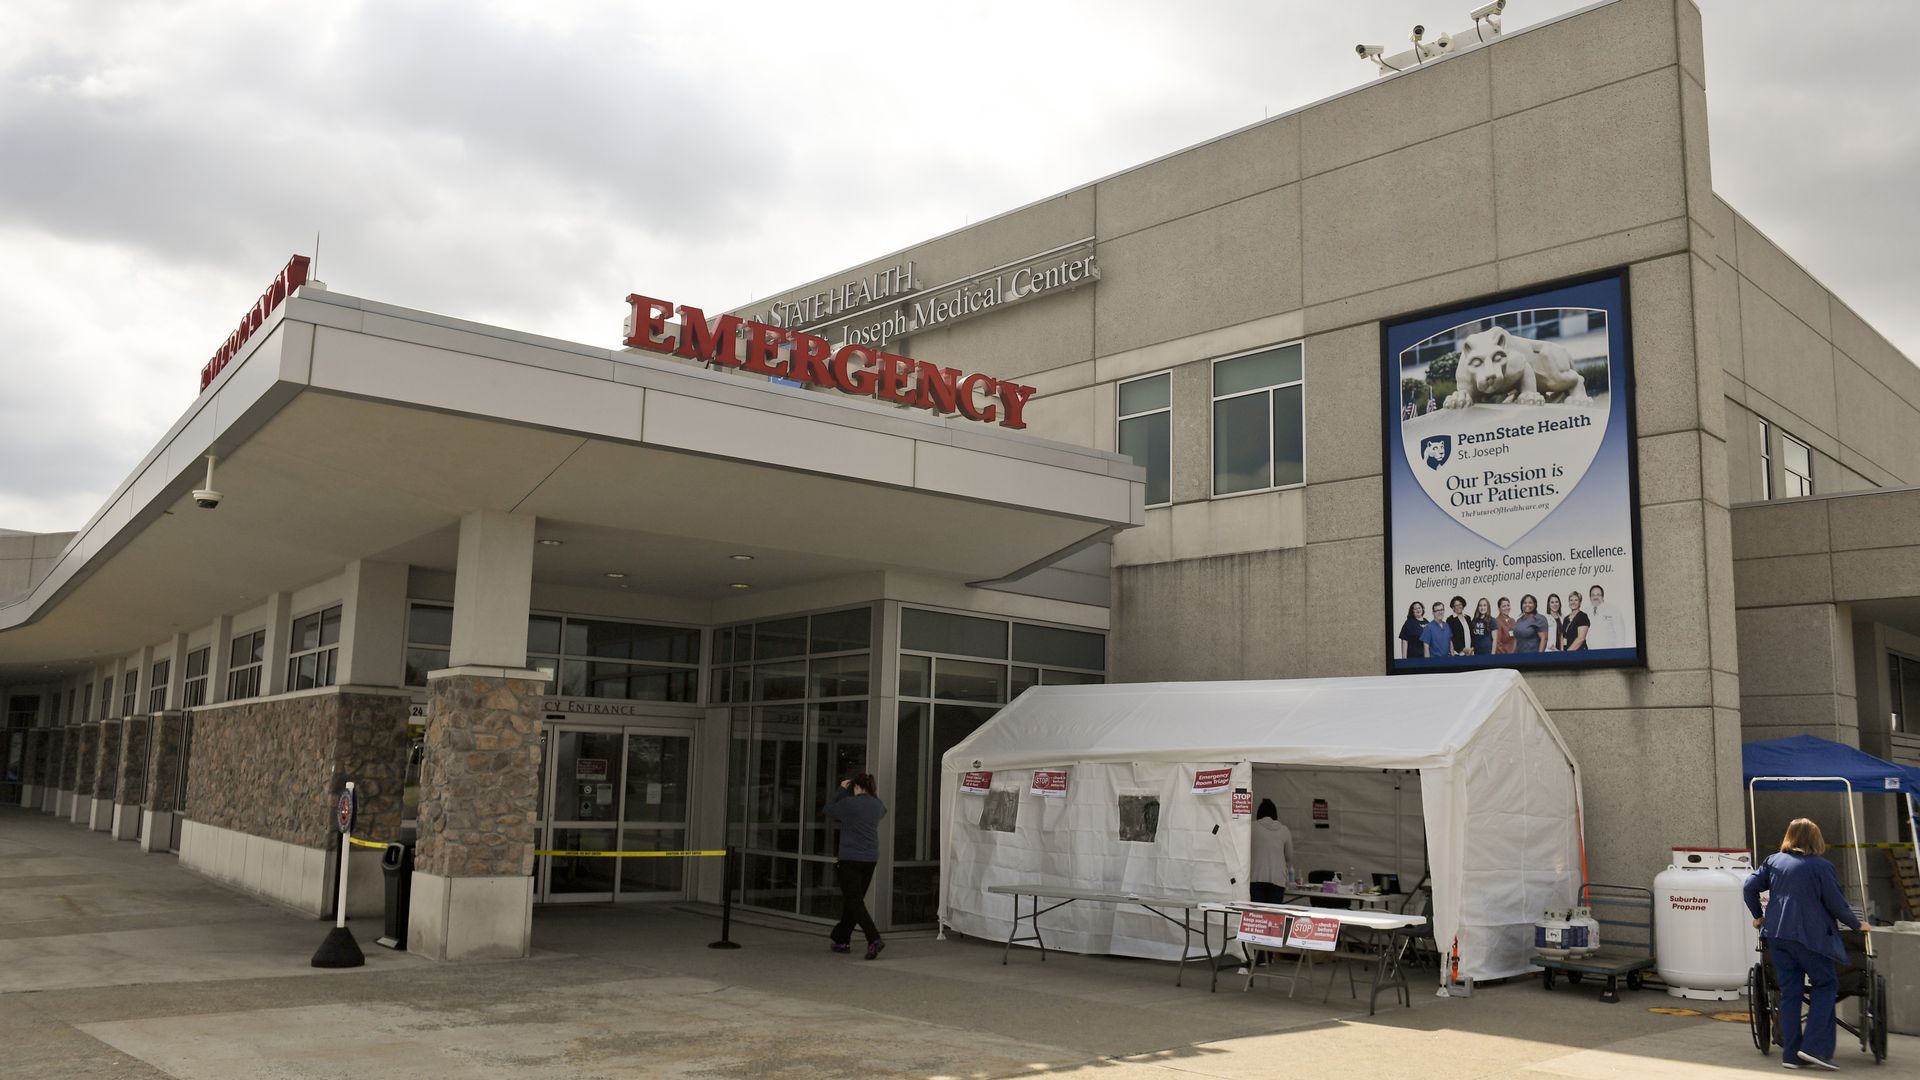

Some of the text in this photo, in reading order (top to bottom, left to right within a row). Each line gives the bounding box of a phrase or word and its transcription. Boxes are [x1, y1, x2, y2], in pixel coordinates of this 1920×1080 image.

[829, 261, 915, 314] HEALTH
[842, 255, 1095, 347] Joseph Medical Center
[624, 293, 1037, 429] EMERGENCY
[1538, 415, 1591, 433] Health
[1458, 443, 1509, 460] St. Joseph
[1446, 463, 1564, 490] Our Passion is
[1450, 482, 1559, 507] Our Patients.
[1404, 545, 1626, 575] Reverence. Integrity. Compassion. Excellence.
[1415, 562, 1614, 588] Delivering an exceptional experience for you.
[412, 707, 423, 717] 24
[1669, 895, 1709, 903] Suburban
[1672, 903, 1706, 911] Propane
[1294, 923, 1312, 933] STOP
